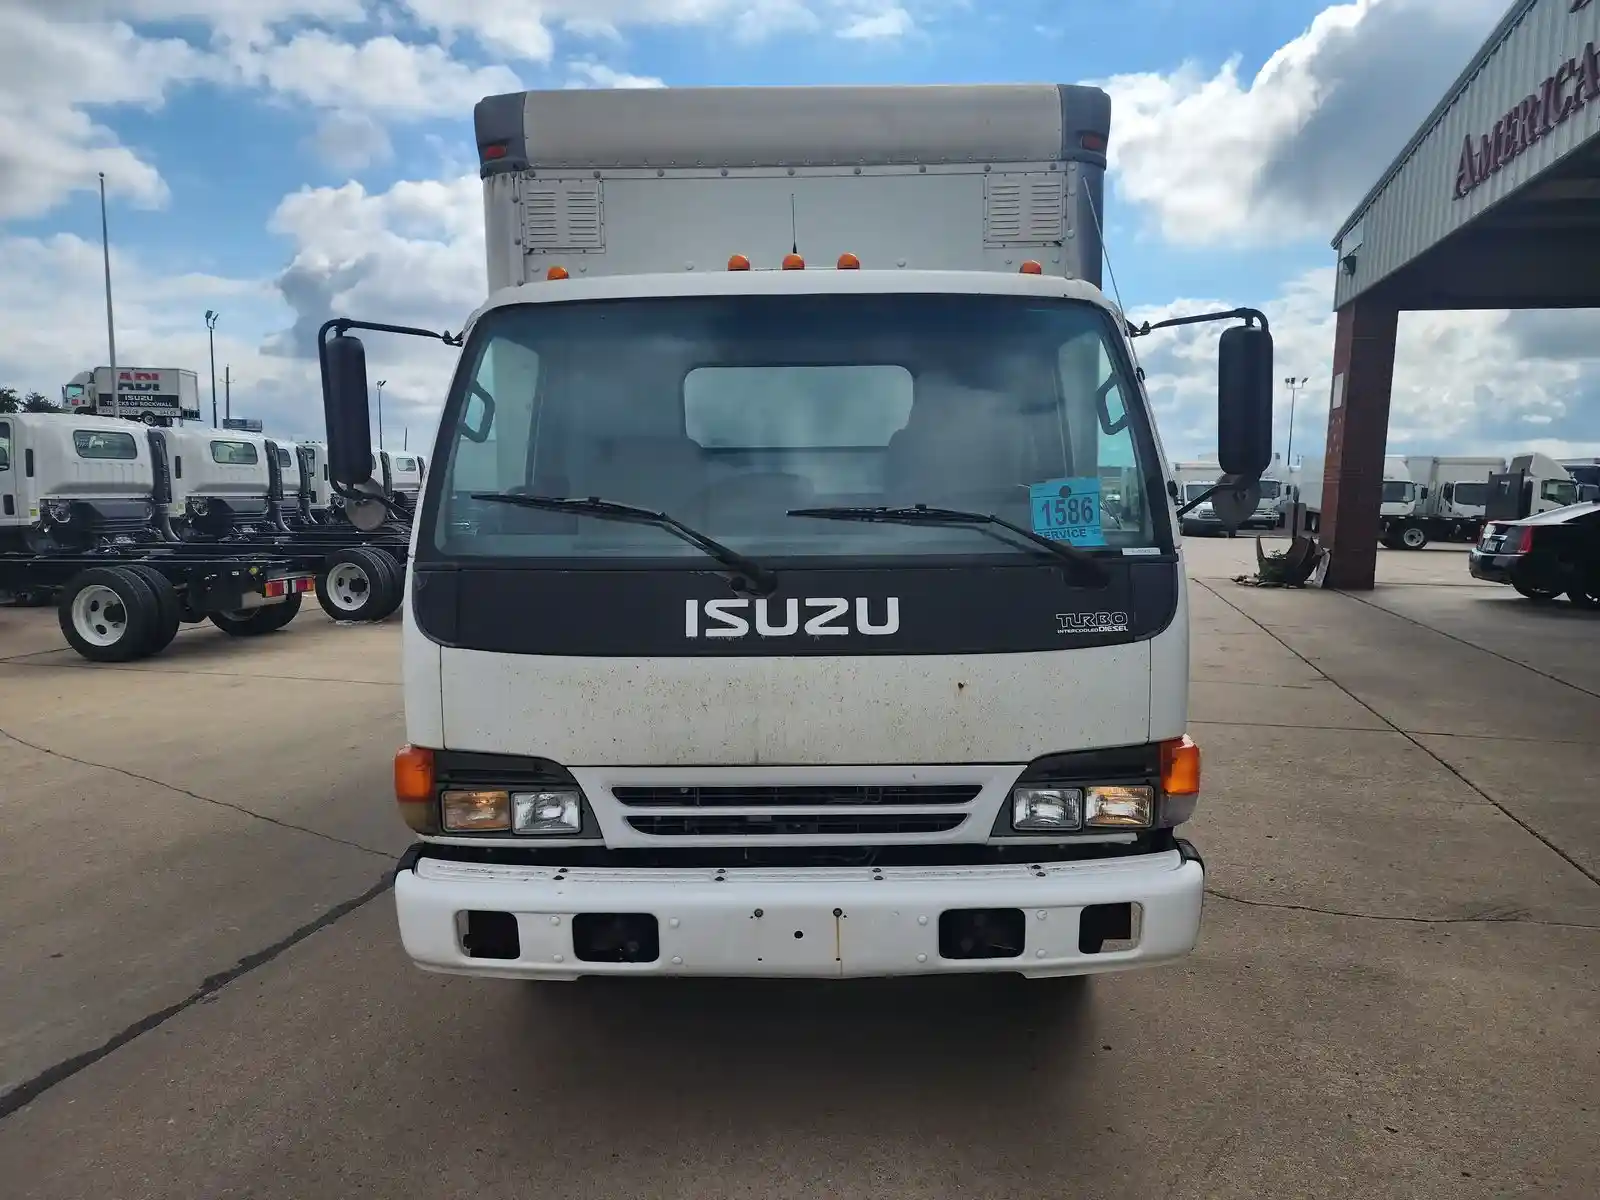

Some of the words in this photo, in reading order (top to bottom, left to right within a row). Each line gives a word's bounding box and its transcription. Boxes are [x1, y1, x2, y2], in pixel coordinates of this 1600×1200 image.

[1453, 42, 1600, 199] AMERICA
[119, 373, 160, 391] ADI
[1041, 498, 1094, 526] 1586
[685, 597, 900, 638] ISUZU
[1056, 612, 1127, 627] TURBO
